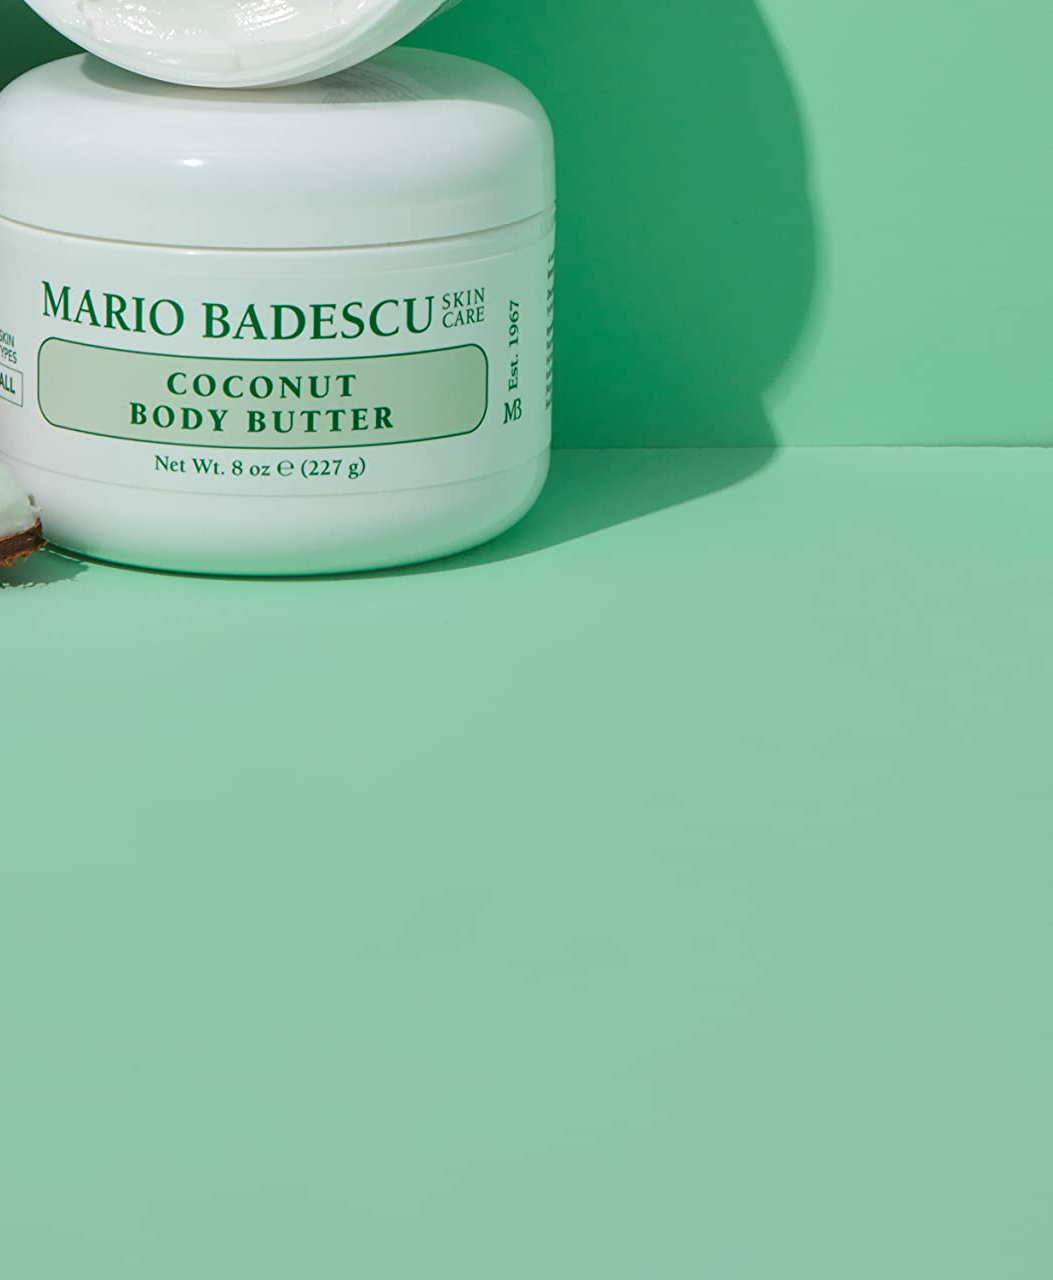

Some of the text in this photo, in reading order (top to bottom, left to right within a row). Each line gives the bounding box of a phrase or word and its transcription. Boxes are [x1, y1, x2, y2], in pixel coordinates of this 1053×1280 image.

[42, 280, 434, 340] MARIO BADESCU
[442, 287, 486, 309] SKIN
[442, 308, 486, 329] CARE
[508, 300, 519, 392] Est. 1967
[167, 372, 356, 399] COCONUT
[130, 402, 393, 433] BODY BUTTER
[155, 455, 186, 473] Net
[192, 458, 225, 475] Wt.
[232, 460, 243, 476] 8
[249, 465, 271, 476] oz
[301, 459, 342, 479] (227
[348, 457, 366, 479] g)
